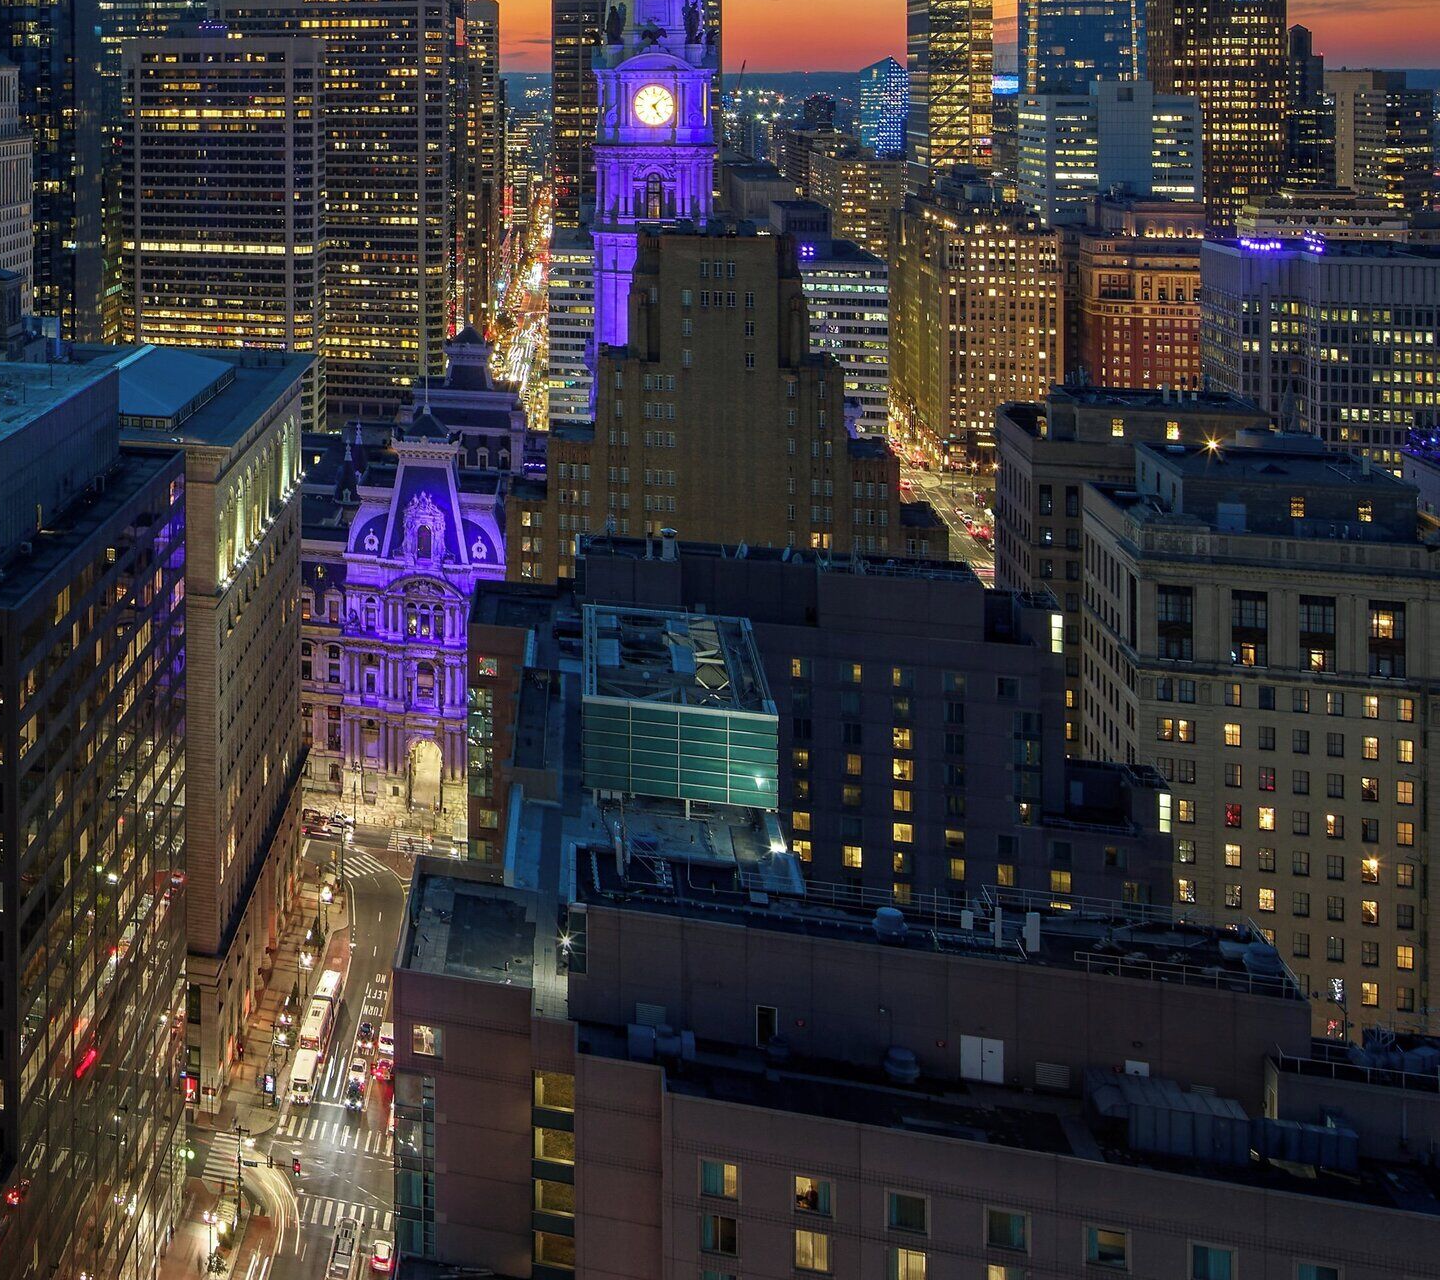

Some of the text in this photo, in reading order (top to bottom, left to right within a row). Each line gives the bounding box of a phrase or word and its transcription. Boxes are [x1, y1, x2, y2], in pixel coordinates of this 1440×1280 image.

[375, 973, 386, 983] NO
[367, 989, 388, 1000] LEFT
[363, 1005, 383, 1016] TURN
